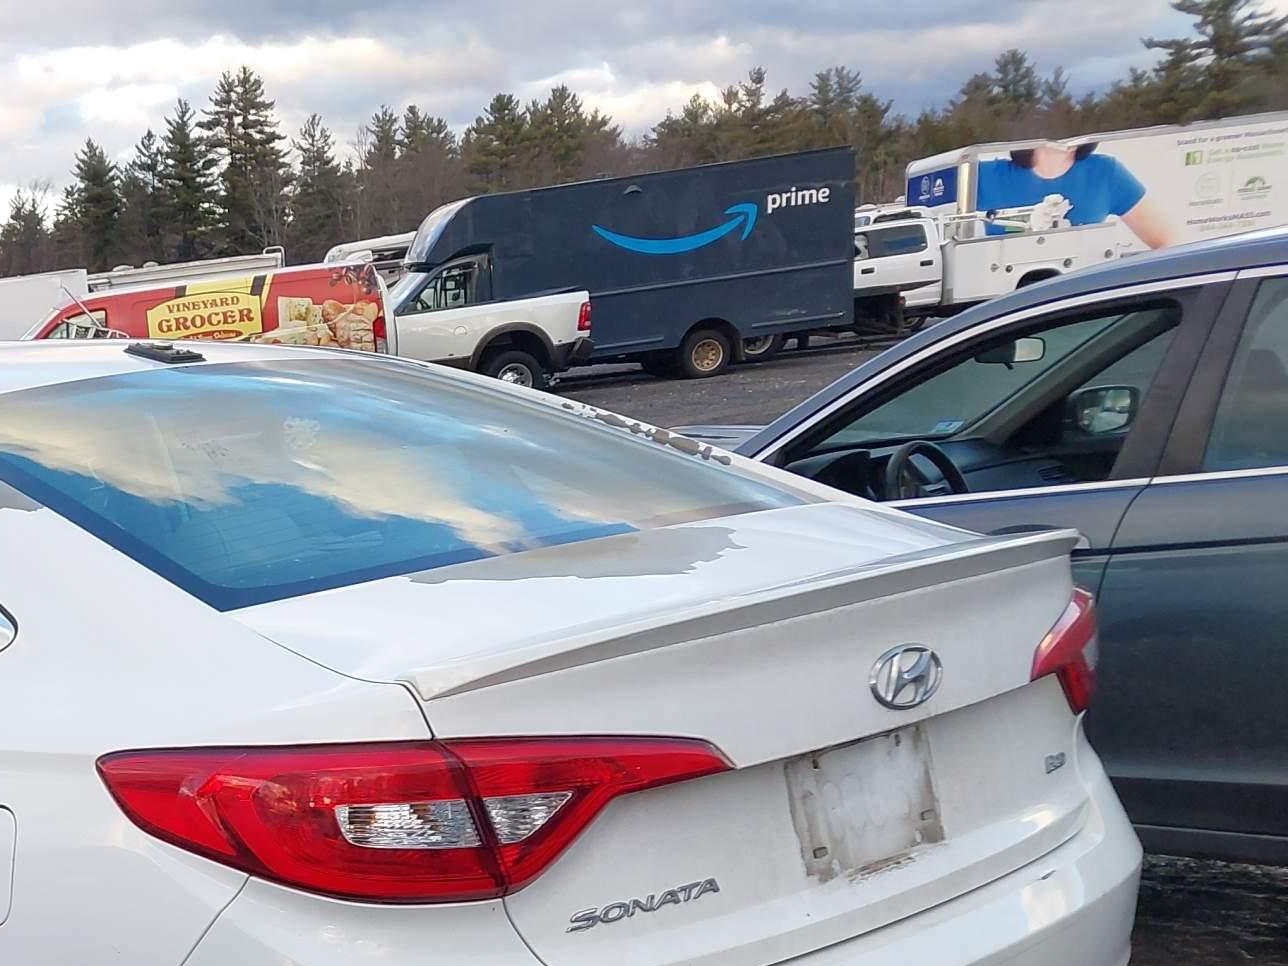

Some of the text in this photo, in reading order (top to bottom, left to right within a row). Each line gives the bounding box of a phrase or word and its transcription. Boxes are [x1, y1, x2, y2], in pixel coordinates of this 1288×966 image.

[767, 186, 830, 214] prime
[166, 295, 241, 314] VINEYARD
[157, 307, 255, 333] GROCER
[565, 877, 721, 934] SONATA
